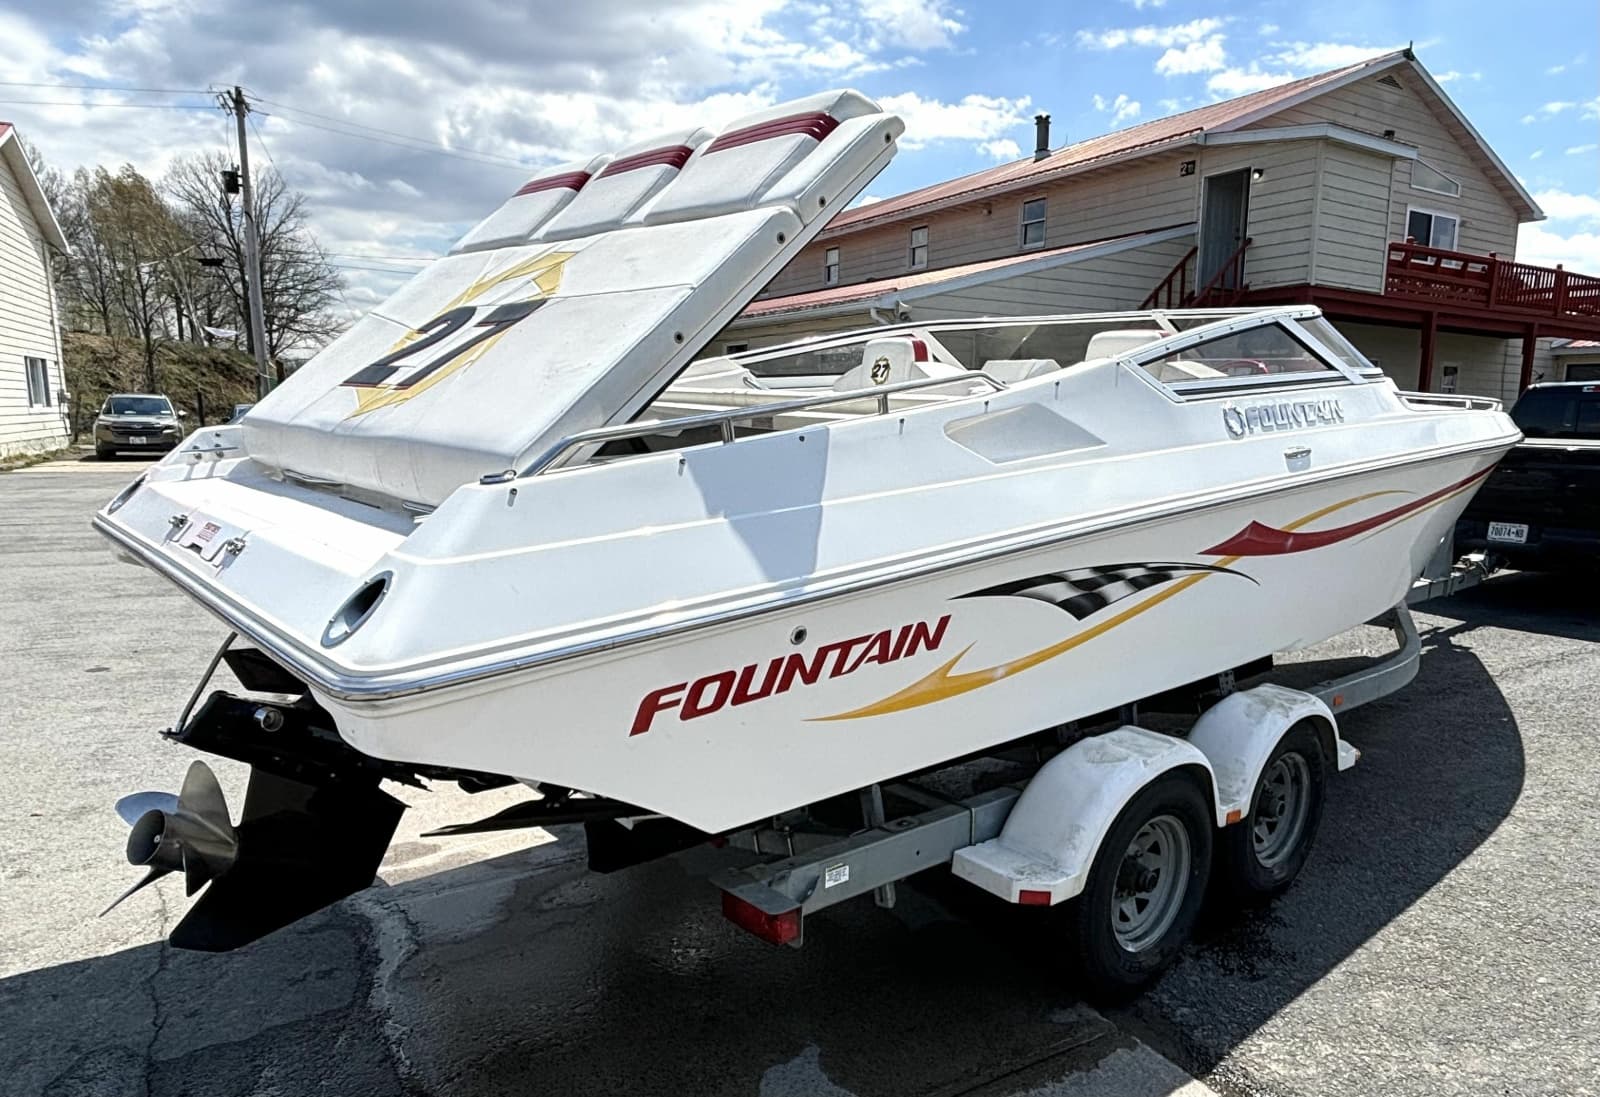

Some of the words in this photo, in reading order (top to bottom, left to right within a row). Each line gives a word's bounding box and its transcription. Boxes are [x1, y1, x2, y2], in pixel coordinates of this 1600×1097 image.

[339, 298, 549, 390] 27
[871, 363, 890, 378] 27
[1245, 399, 1345, 434] FOUNTAIN
[629, 614, 952, 737] FOUNTAIN
